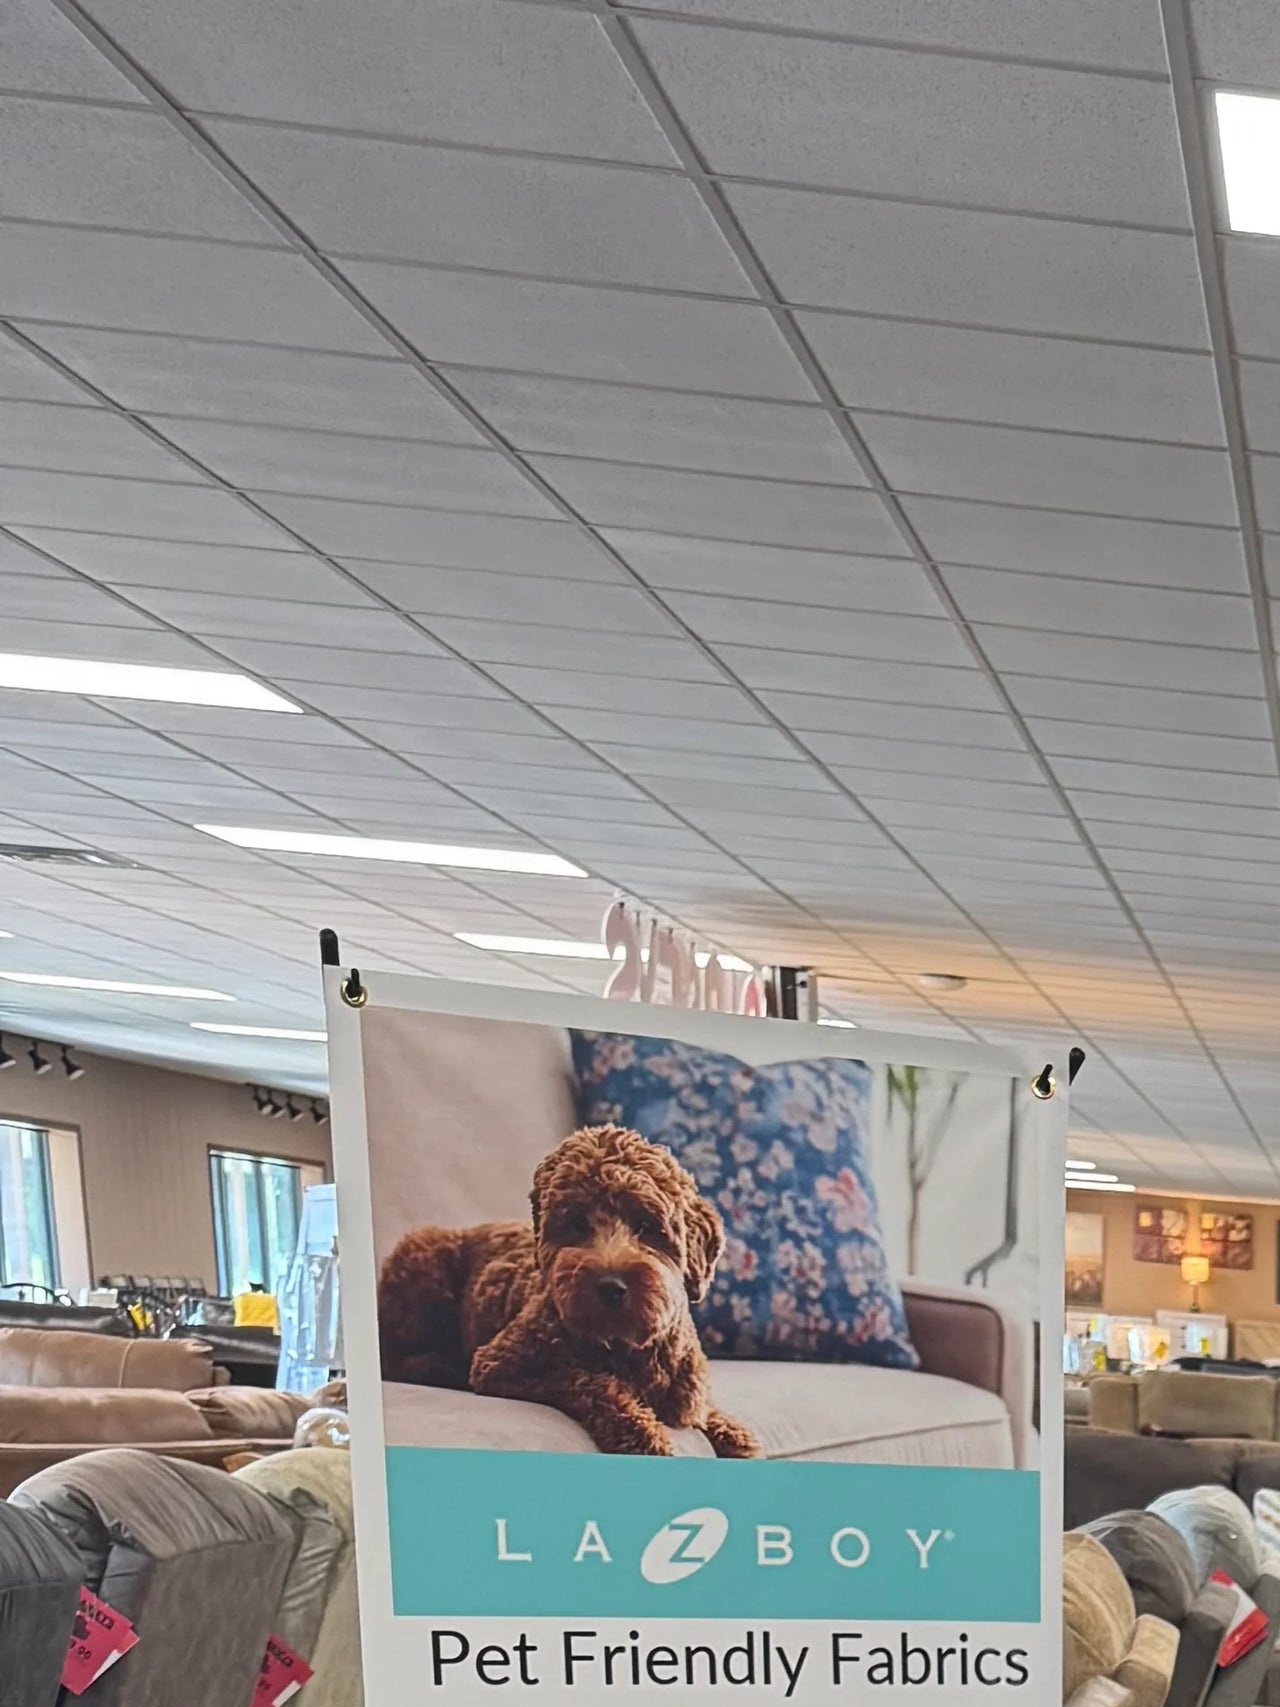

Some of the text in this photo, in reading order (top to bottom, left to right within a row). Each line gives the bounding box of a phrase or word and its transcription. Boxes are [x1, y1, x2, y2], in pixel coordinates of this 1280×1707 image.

[431, 1630, 1028, 1697] Pet Friendly Fabrics
